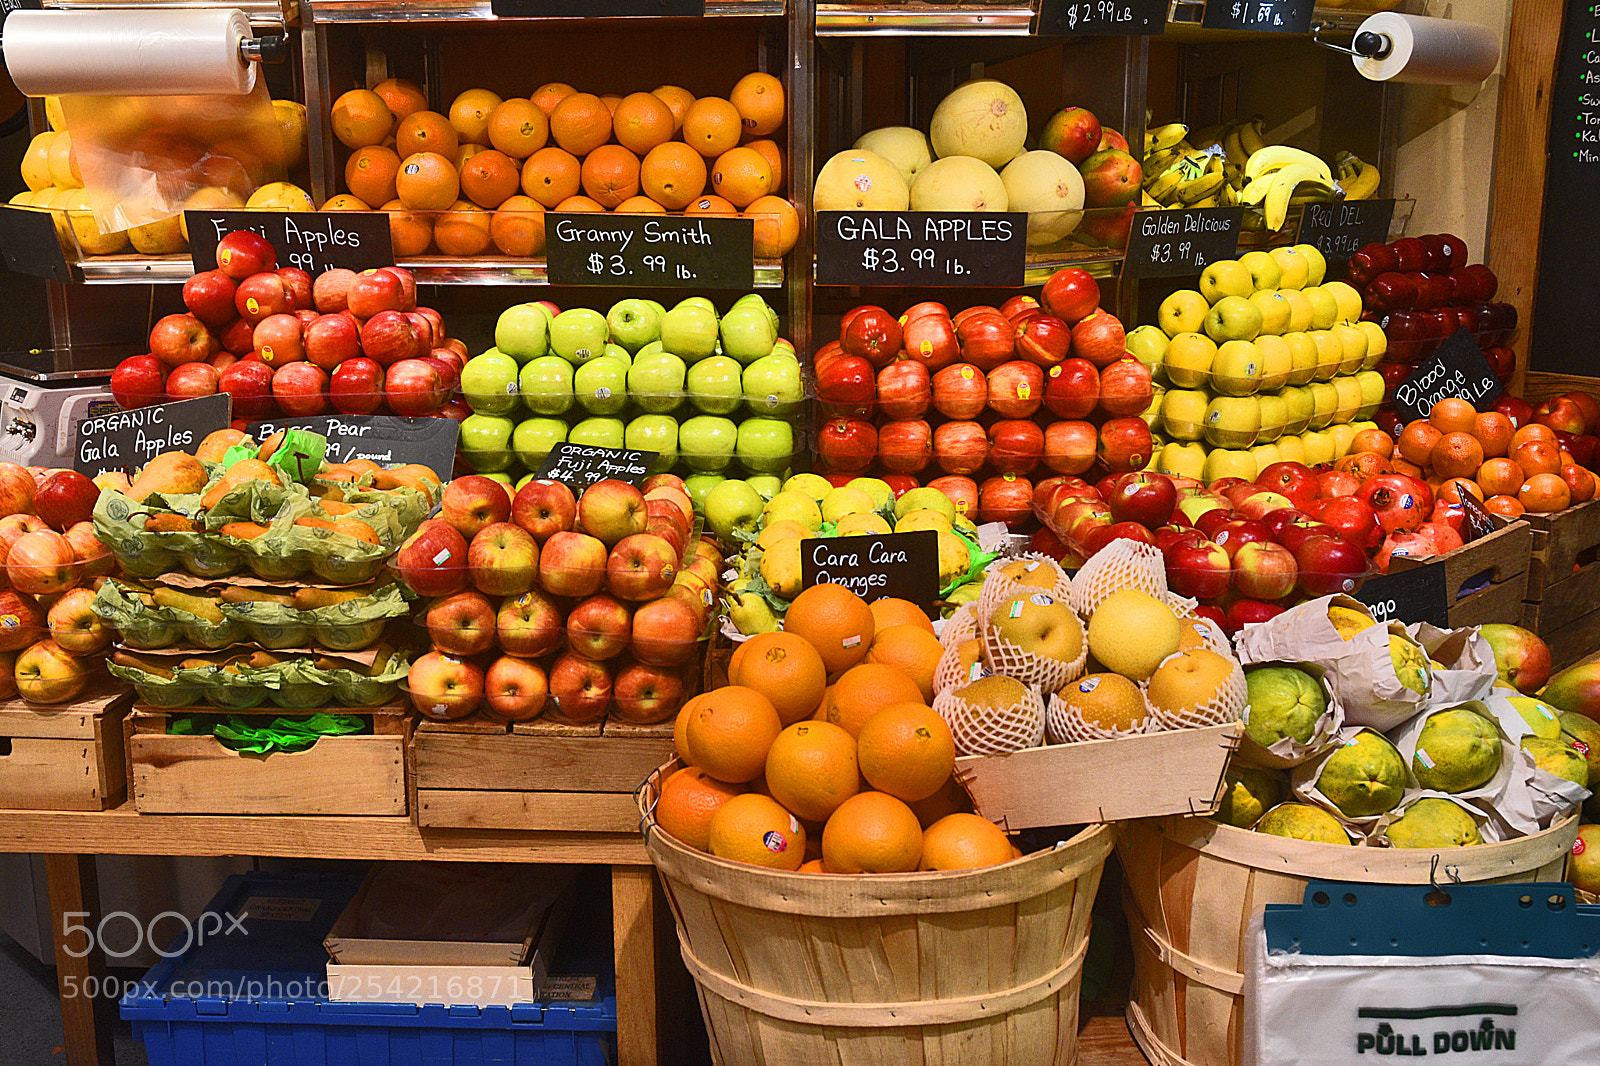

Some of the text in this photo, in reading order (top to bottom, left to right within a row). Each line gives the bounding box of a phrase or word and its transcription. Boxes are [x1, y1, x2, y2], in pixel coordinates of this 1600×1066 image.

[837, 216, 1013, 242] GALA APPLES
[1142, 212, 1232, 237] Golden Delicious
[1310, 204, 1335, 228] Red
[284, 216, 360, 253] Apples
[556, 220, 712, 253] Granny Smith
[1396, 357, 1446, 406] Blood
[1417, 369, 1466, 417] Orange
[81, 407, 165, 436] ORGANIC
[326, 419, 372, 437] Pear
[80, 424, 193, 464] Gala Apples
[560, 445, 642, 461] ORGANIC
[557, 456, 647, 475] Fuji Apples
[813, 541, 908, 567] Cara Cara
[816, 570, 888, 597] Oranges
[1357, 1028, 1516, 1056] PULL DOWN
